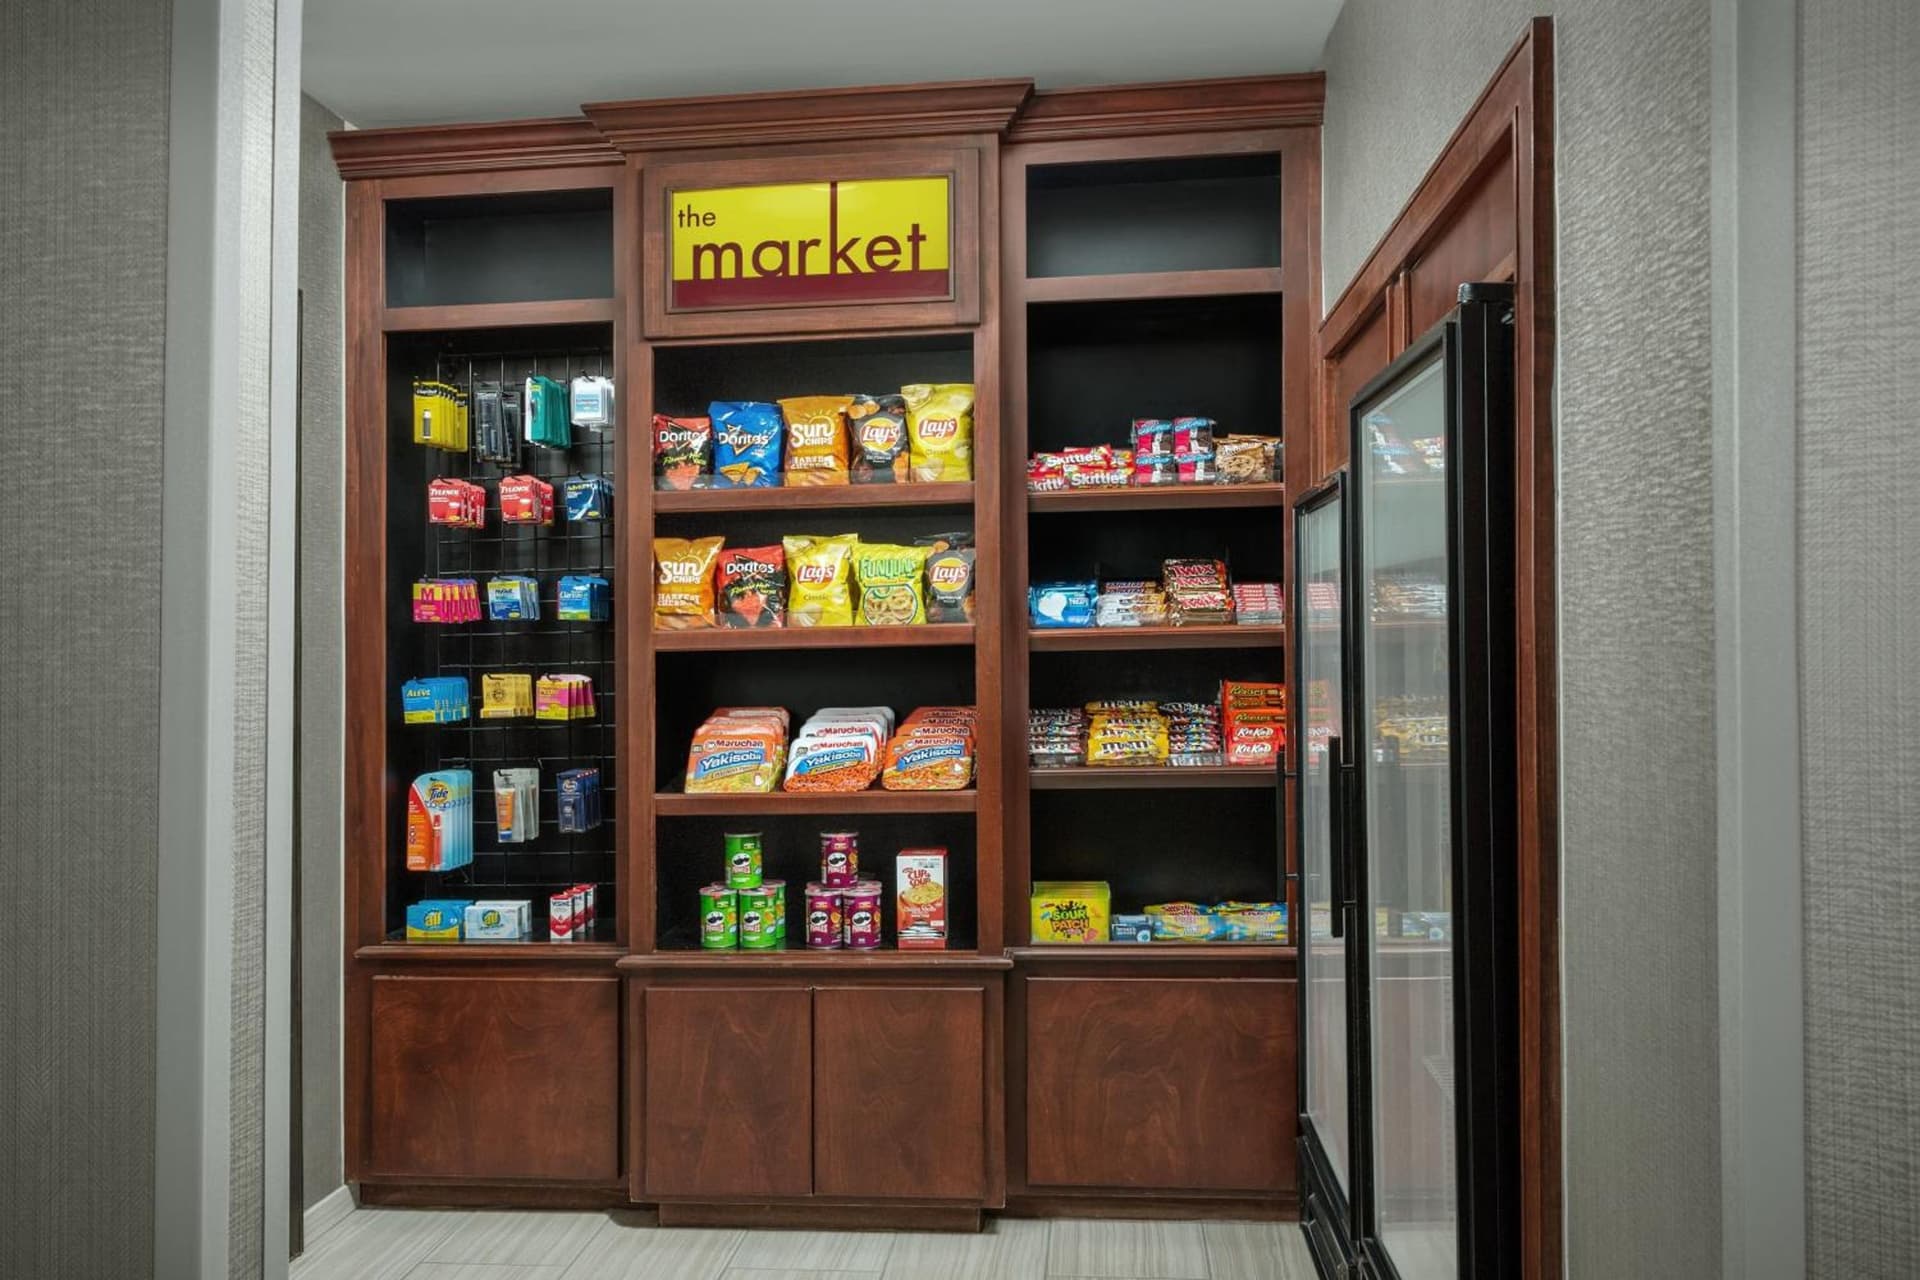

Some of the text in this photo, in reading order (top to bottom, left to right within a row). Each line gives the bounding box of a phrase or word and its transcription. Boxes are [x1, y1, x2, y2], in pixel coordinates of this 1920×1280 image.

[678, 204, 716, 228] the
[692, 181, 927, 280] market
[790, 421, 832, 448] Sun
[863, 424, 899, 445] Lay's
[920, 417, 955, 438] Lay's
[659, 431, 708, 444] Doritos
[718, 432, 769, 446] Doritos
[1046, 453, 1102, 467] Skittles
[1070, 472, 1127, 486] Skittles
[660, 560, 703, 584] Sun
[726, 561, 775, 575] Doritos
[797, 564, 834, 584] Lay's
[931, 564, 967, 584] Lay's
[672, 575, 701, 584] CHIPS
[824, 726, 869, 735] Maruchan
[922, 727, 969, 735] Maruchan
[715, 739, 763, 748] Maruchan
[820, 740, 864, 749] Maruchan
[914, 738, 964, 746] Maruchan
[701, 751, 762, 772] Yakisoba
[806, 751, 862, 767] Yakisoba
[903, 748, 961, 765] Yakisoba
[430, 788, 448, 800] Tide
[424, 911, 442, 927] all
[1051, 909, 1086, 920] SOUR
[1052, 918, 1089, 930] PATCH
